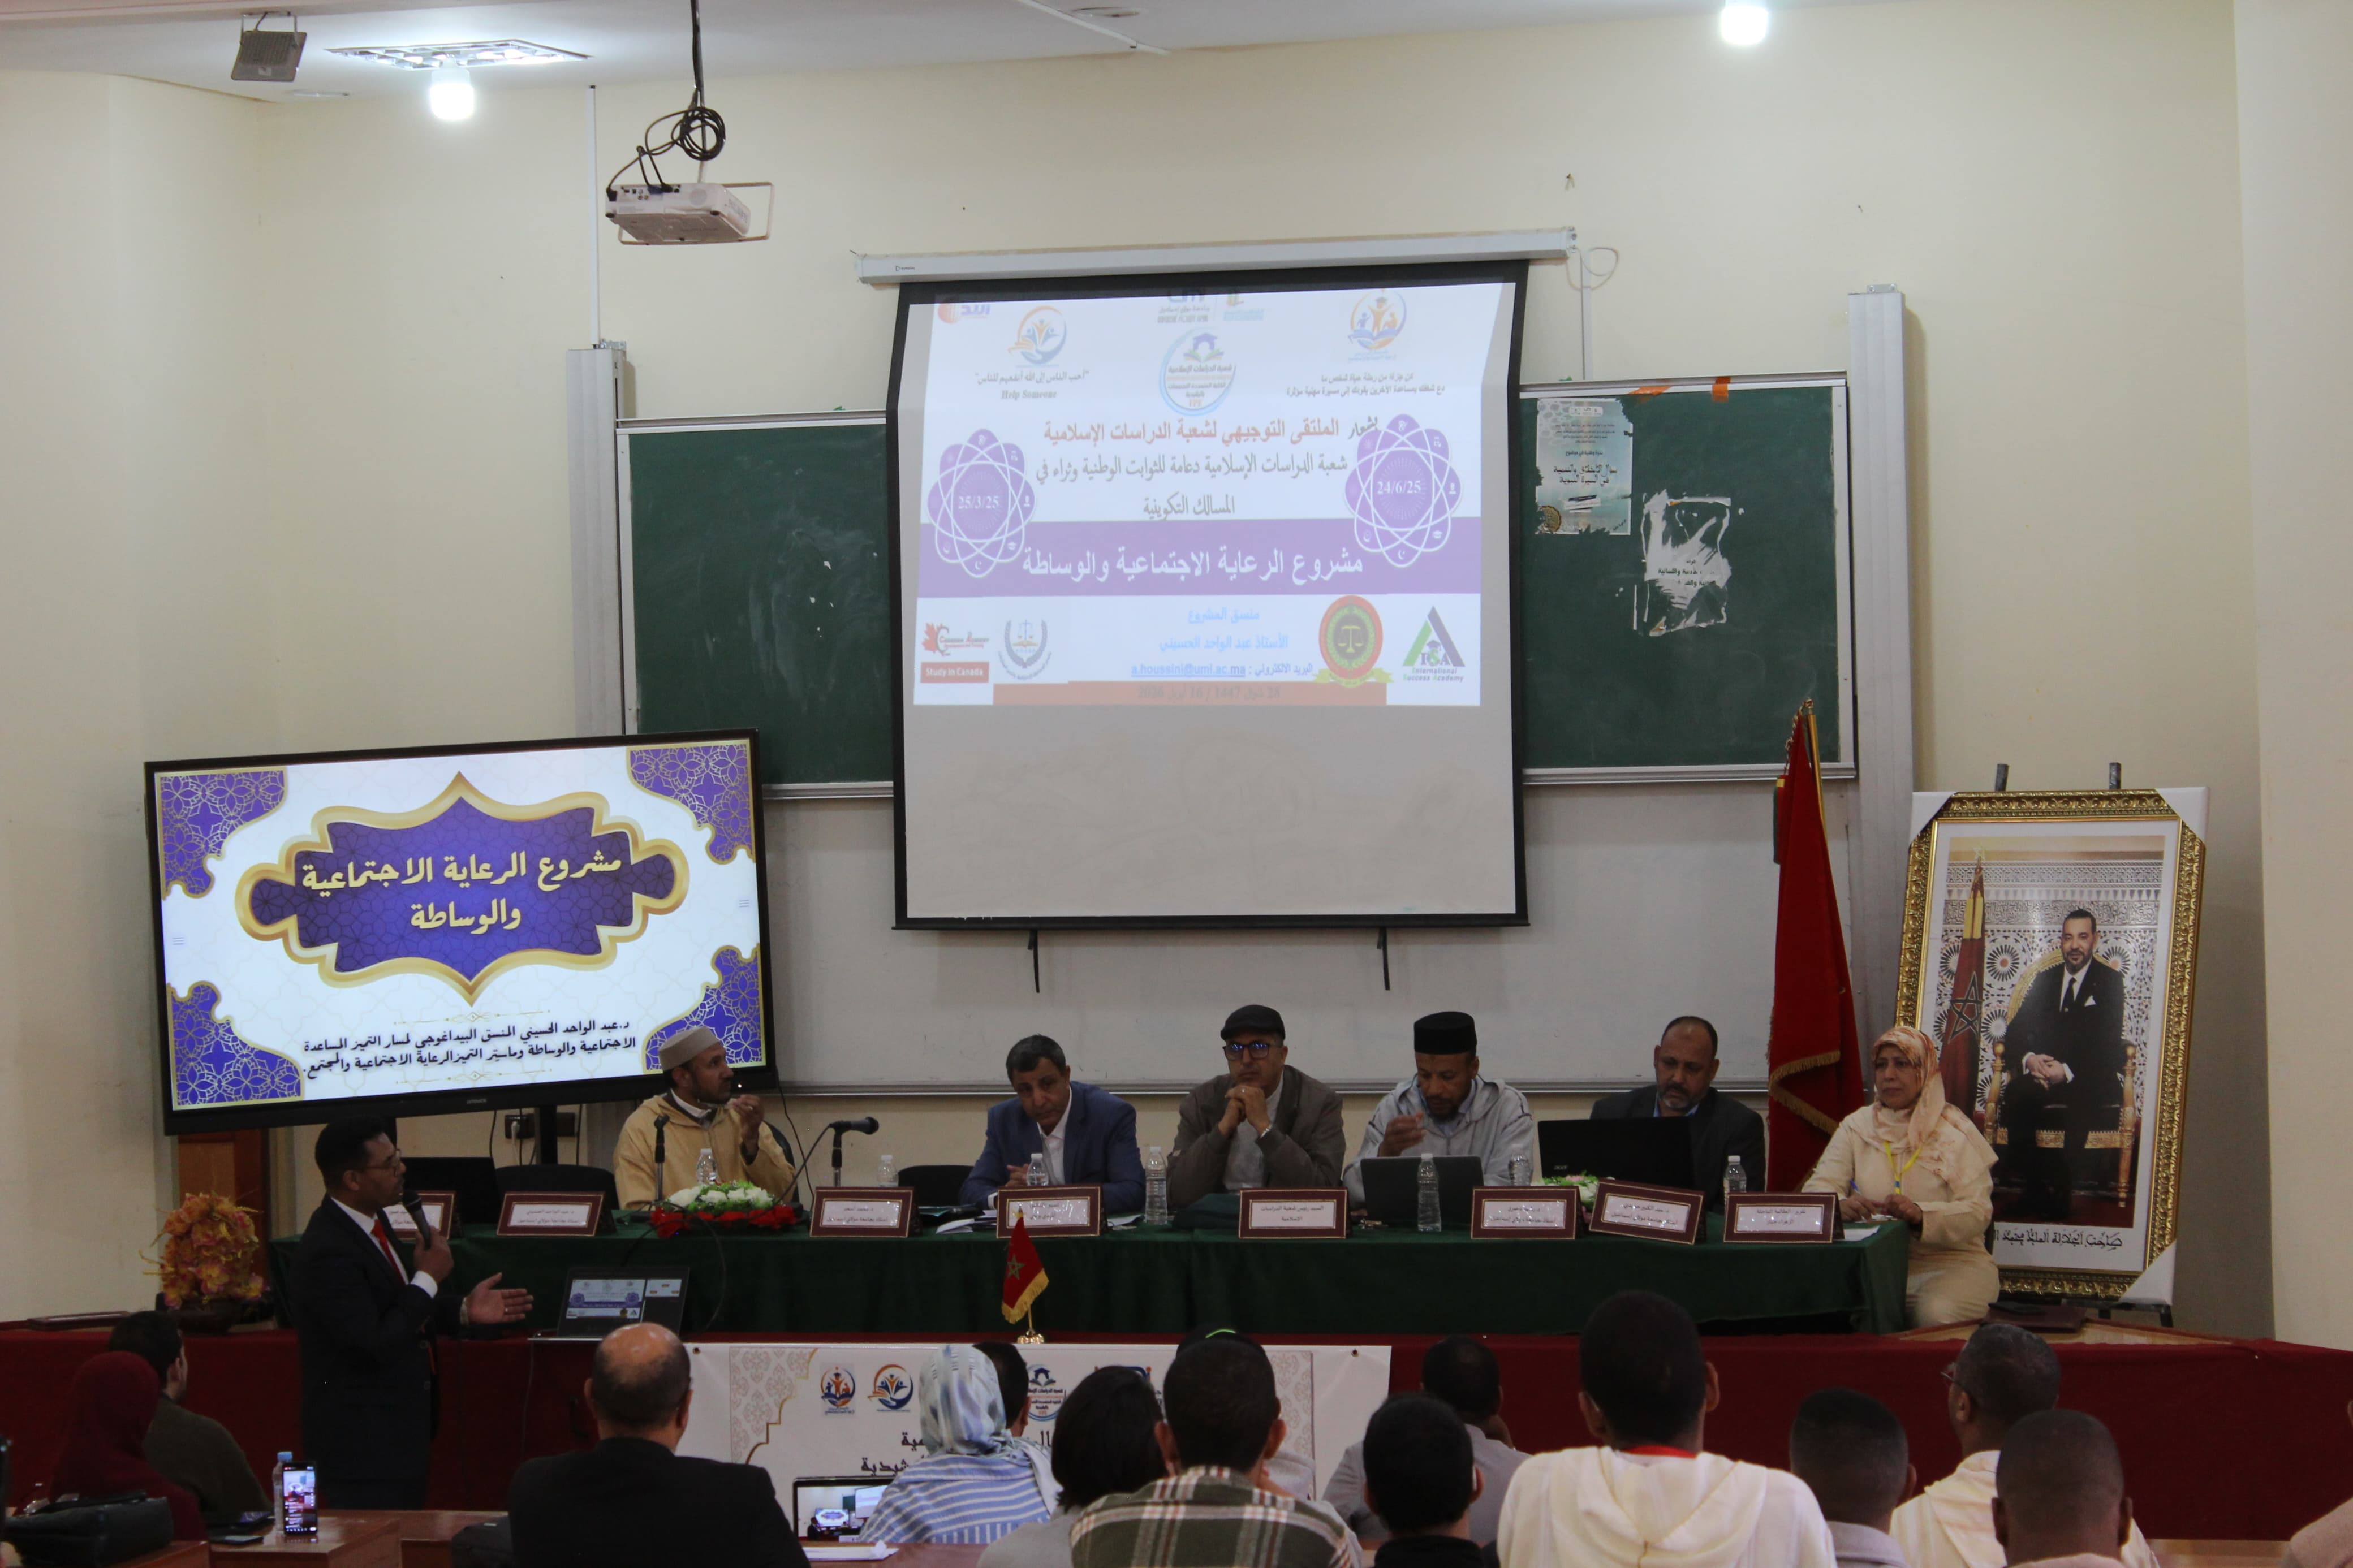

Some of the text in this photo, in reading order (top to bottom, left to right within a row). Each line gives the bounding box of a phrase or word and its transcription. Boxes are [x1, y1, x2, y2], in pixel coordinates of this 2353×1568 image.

[1024, 372, 1035, 381] الله
[1193, 364, 1217, 373] الدراسات
[1046, 372, 1067, 383] الناس
[1328, 373, 1348, 383] شخص
[1378, 374, 1387, 382] من
[1001, 390, 1057, 400] Help Someone
[1304, 386, 1321, 397] مهنية
[1322, 387, 1339, 396] مسيرة
[1436, 385, 1445, 395] دع
[1044, 421, 1104, 447] الإسلامية
[1110, 421, 1171, 444] الدراسات
[1177, 418, 1217, 443] لشعبة
[1222, 420, 1285, 446] التوجيهي
[1290, 418, 1339, 444] الملتقى
[1036, 460, 1049, 485] في
[1083, 454, 1121, 480] الوطنية
[1126, 454, 1165, 480] للثوابت
[1170, 454, 1200, 475] دعامة
[1204, 452, 1257, 480] الإسلامية
[1262, 452, 1313, 478] الدراسات
[1318, 453, 1347, 476] شعبة
[1377, 480, 1421, 494] 24/6/25
[959, 495, 999, 509] 25/3/25
[1144, 491, 1235, 521] المسالك التكوينية
[1022, 545, 1363, 585] مشروع الرعاية الاجتماعية والوساطة
[1188, 607, 1260, 624] منسق المشروع
[1160, 636, 1200, 652] الحسيني
[1204, 636, 1232, 651] الواحد
[1235, 637, 1252, 649] عبد
[925, 668, 946, 677] Study
[1131, 663, 1245, 677] a.houssini@umi.ac.ma
[1294, 663, 1313, 676] البريد
[1433, 674, 1463, 683] Academy
[1139, 686, 1164, 698] 2026
[1190, 686, 1203, 698] 16
[1215, 686, 1240, 698] 1447
[1267, 686, 1280, 698] 28
[302, 850, 622, 897] مشروع الرعاية الاجتماعية
[410, 898, 521, 934] والوساطة
[520, 1022, 558, 1044] الحسيني
[563, 1020, 596, 1035] الواحد
[304, 1038, 347, 1052] المساعدة
[351, 1035, 381, 1052] التميز
[384, 1033, 411, 1048] لمسار
[415, 1028, 477, 1049] البيداغوجي
[580, 1037, 636, 1055] الاجتماعية
[486, 1046, 524, 1062] وماستر
[528, 1042, 576, 1057] والوساطة
[355, 1053, 412, 1071] الاجتماعية
[2052, 1229, 2083, 1247] الجلالة
[2085, 1231, 2122, 1251] صاحب
